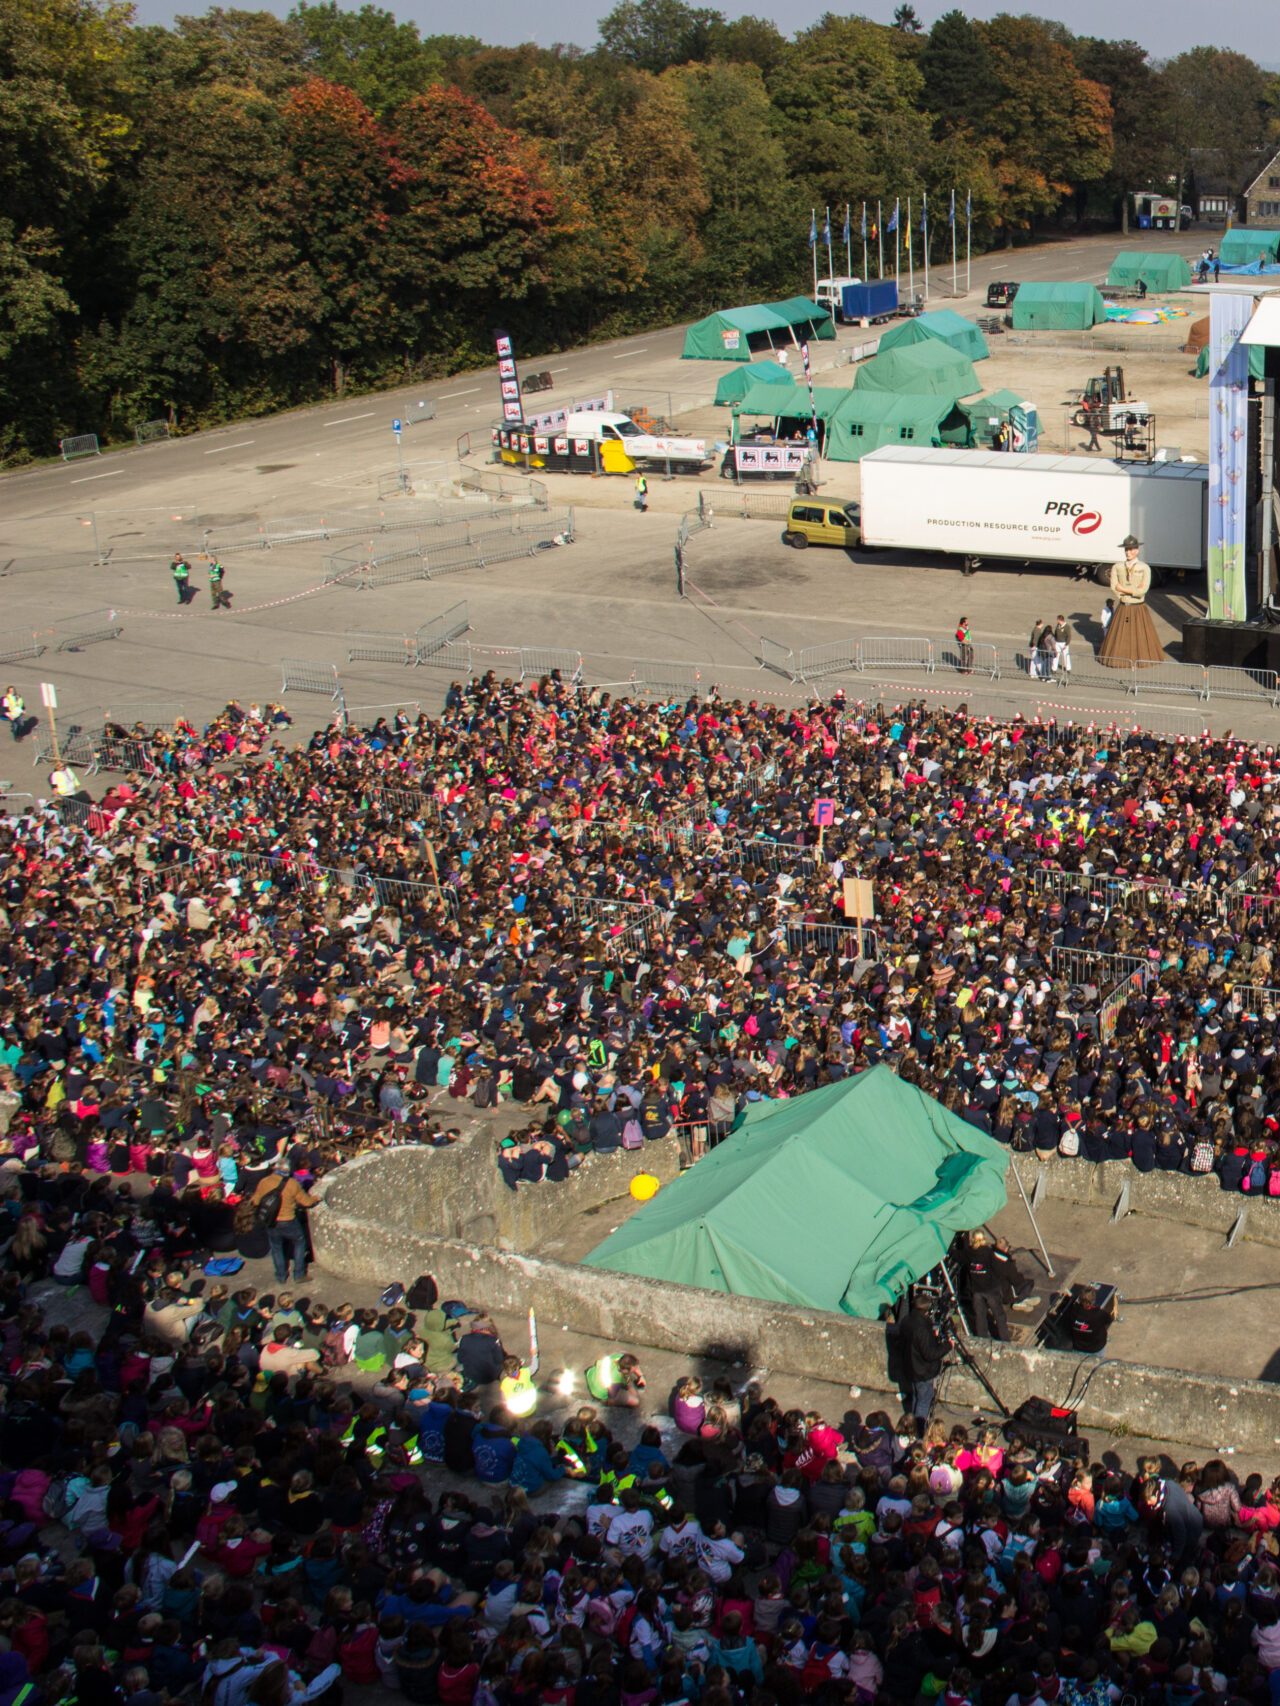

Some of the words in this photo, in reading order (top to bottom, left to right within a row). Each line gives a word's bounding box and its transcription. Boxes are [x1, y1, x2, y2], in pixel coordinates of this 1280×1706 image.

[1044, 501, 1085, 516] PRG
[927, 518, 981, 528] PRODUCTION
[984, 522, 1029, 531] RESOURCE
[1032, 525, 1061, 533] GROUP
[818, 803, 831, 823] F
